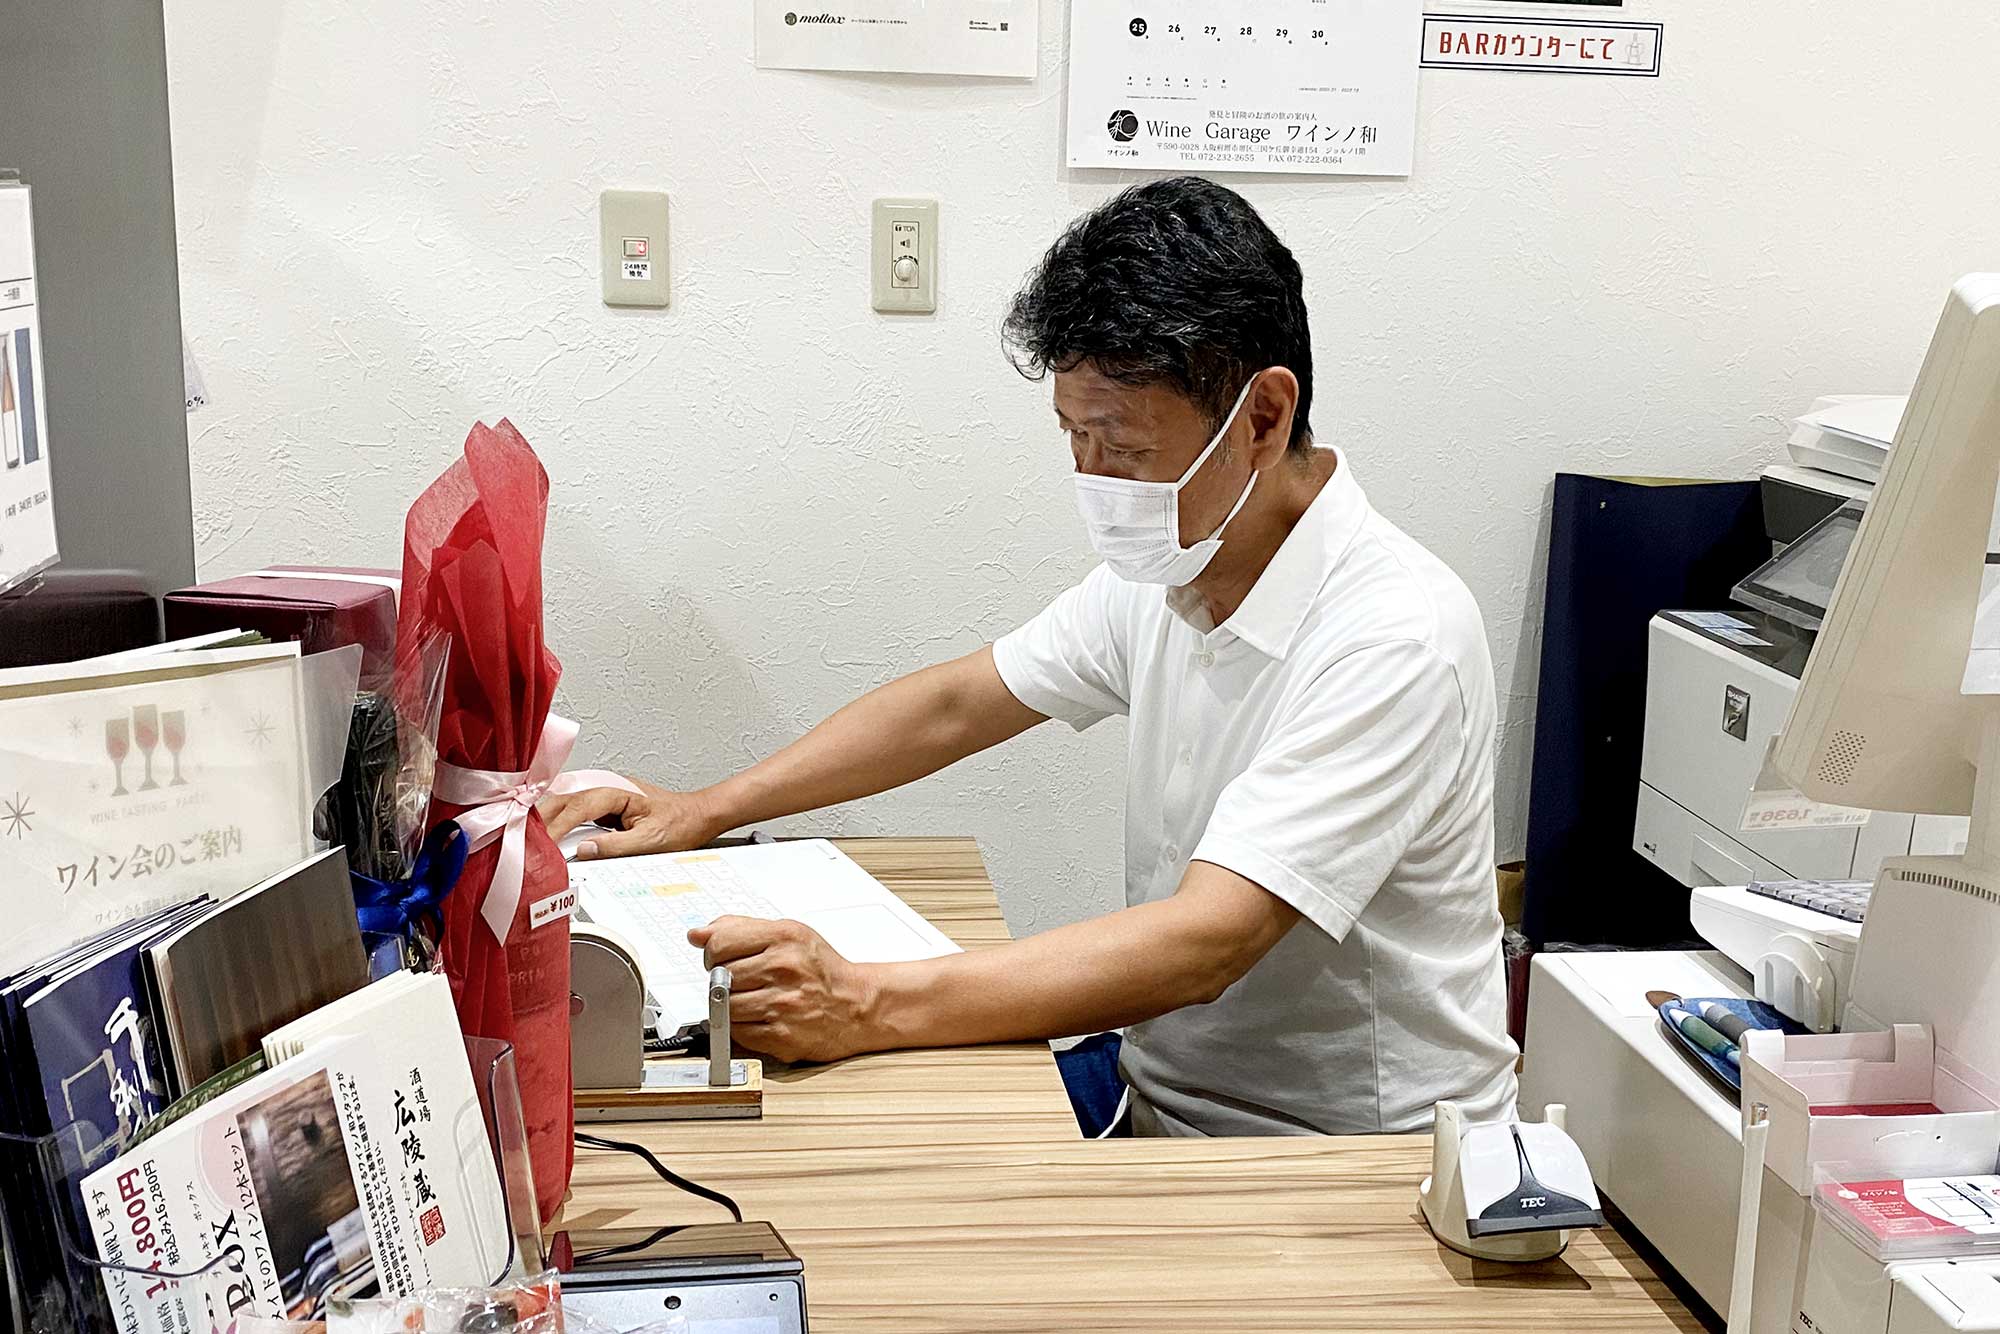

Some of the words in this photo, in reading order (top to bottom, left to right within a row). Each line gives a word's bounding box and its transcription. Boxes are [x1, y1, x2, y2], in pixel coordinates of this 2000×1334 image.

[1132, 23, 1145, 33] 25
[1168, 24, 1181, 33] 26
[1204, 26, 1217, 35] 27
[1240, 27, 1253, 36] 28
[1276, 29, 1288, 38] 29
[1312, 30, 1324, 39] 30
[1439, 31, 1615, 60] BARカウンターにて
[1146, 120, 1192, 138] Wine
[1205, 121, 1271, 144] Garage
[1287, 124, 1377, 144] ワインノ和
[1180, 152, 1197, 160] TEL
[1268, 154, 1285, 162] FAX
[56, 825, 243, 894] ワイン会のご案内
[550, 894, 575, 913] ¥100
[143, 1159, 182, 1267] 税込み16,280円
[1520, 1196, 1546, 1209] TEC
